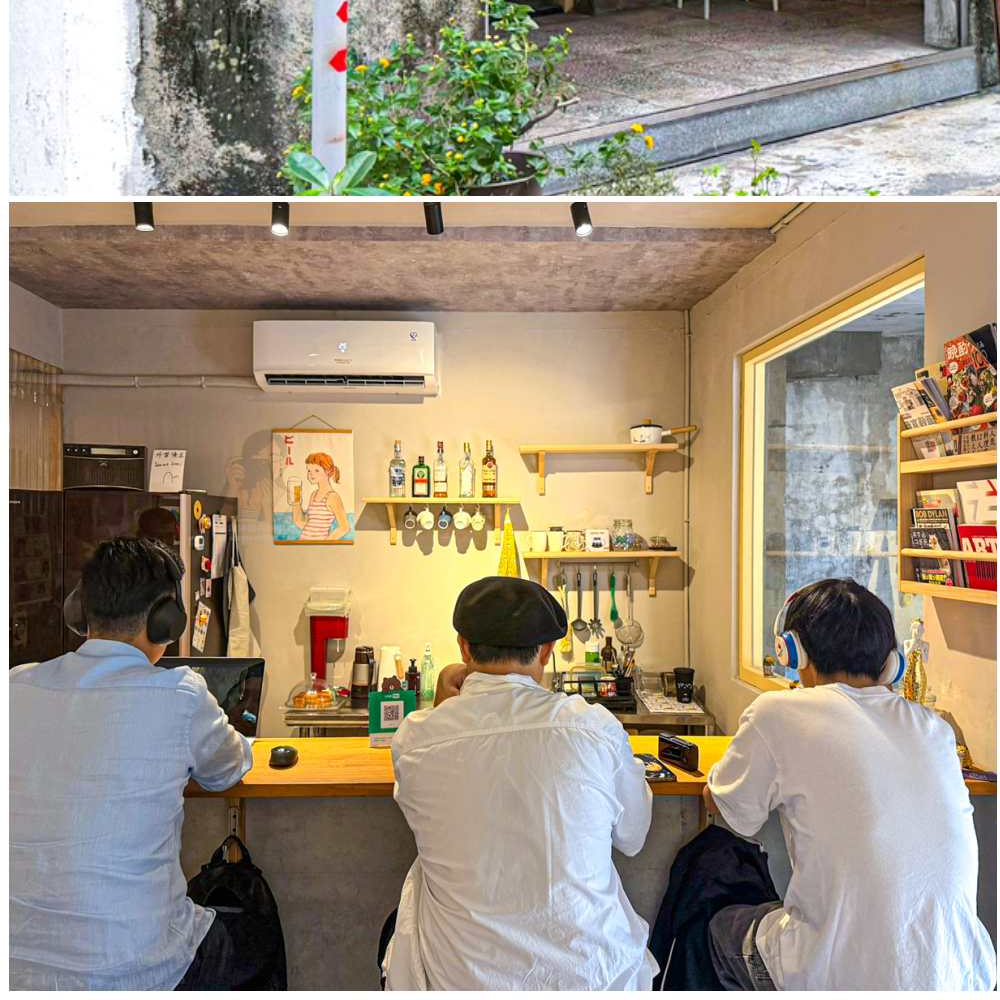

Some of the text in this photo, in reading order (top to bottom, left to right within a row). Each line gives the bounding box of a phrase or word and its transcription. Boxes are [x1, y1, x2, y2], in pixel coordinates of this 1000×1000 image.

[284, 435, 295, 466] ビール
[928, 508, 948, 519] DYLAN
